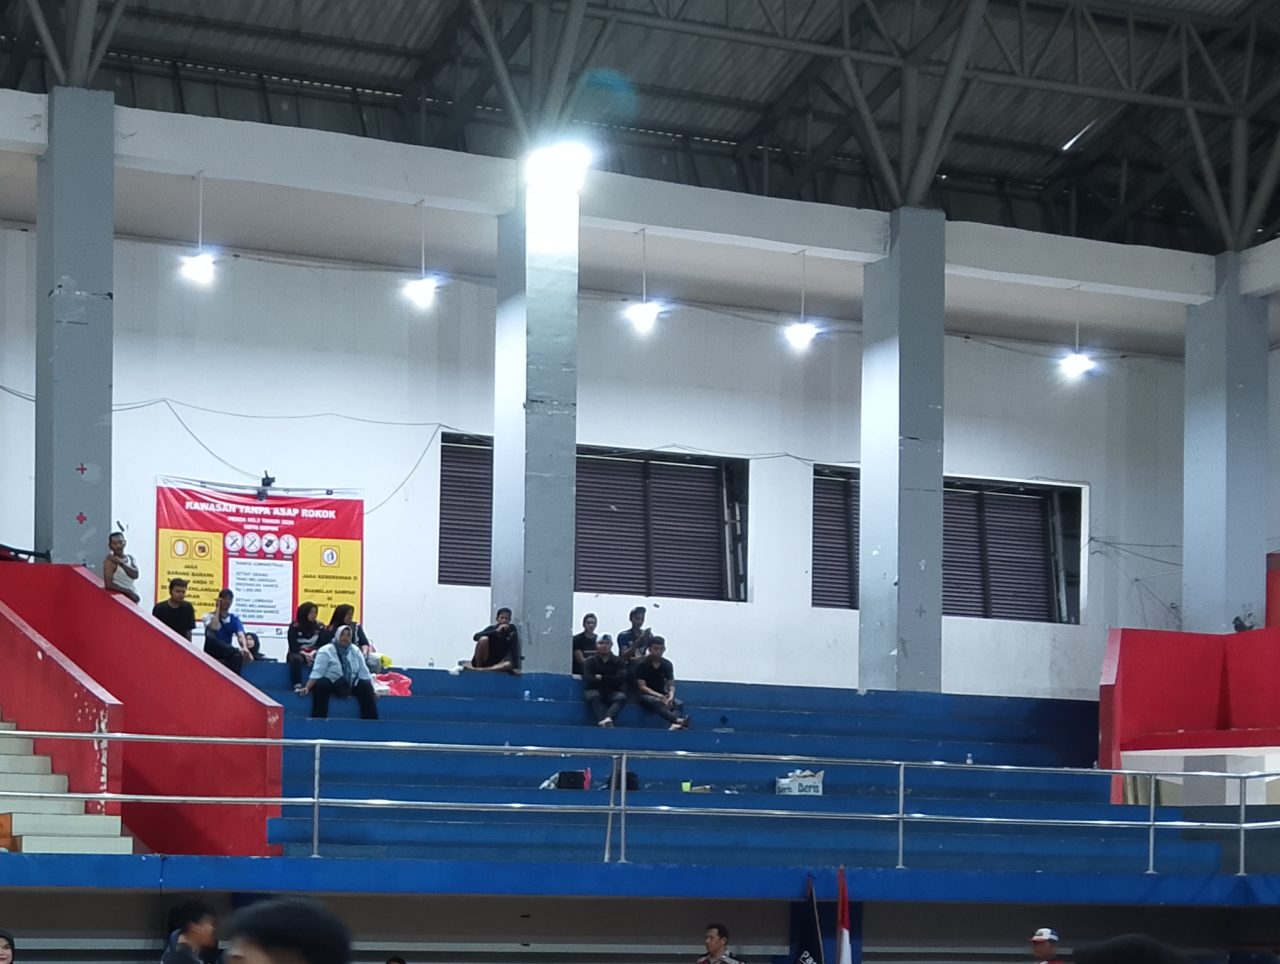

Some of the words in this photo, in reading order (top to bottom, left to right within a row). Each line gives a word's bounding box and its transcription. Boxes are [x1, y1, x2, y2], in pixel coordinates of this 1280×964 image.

[185, 501, 236, 513] KAWASAN
[272, 507, 299, 517] ASAP
[301, 509, 336, 519] ROKOK
